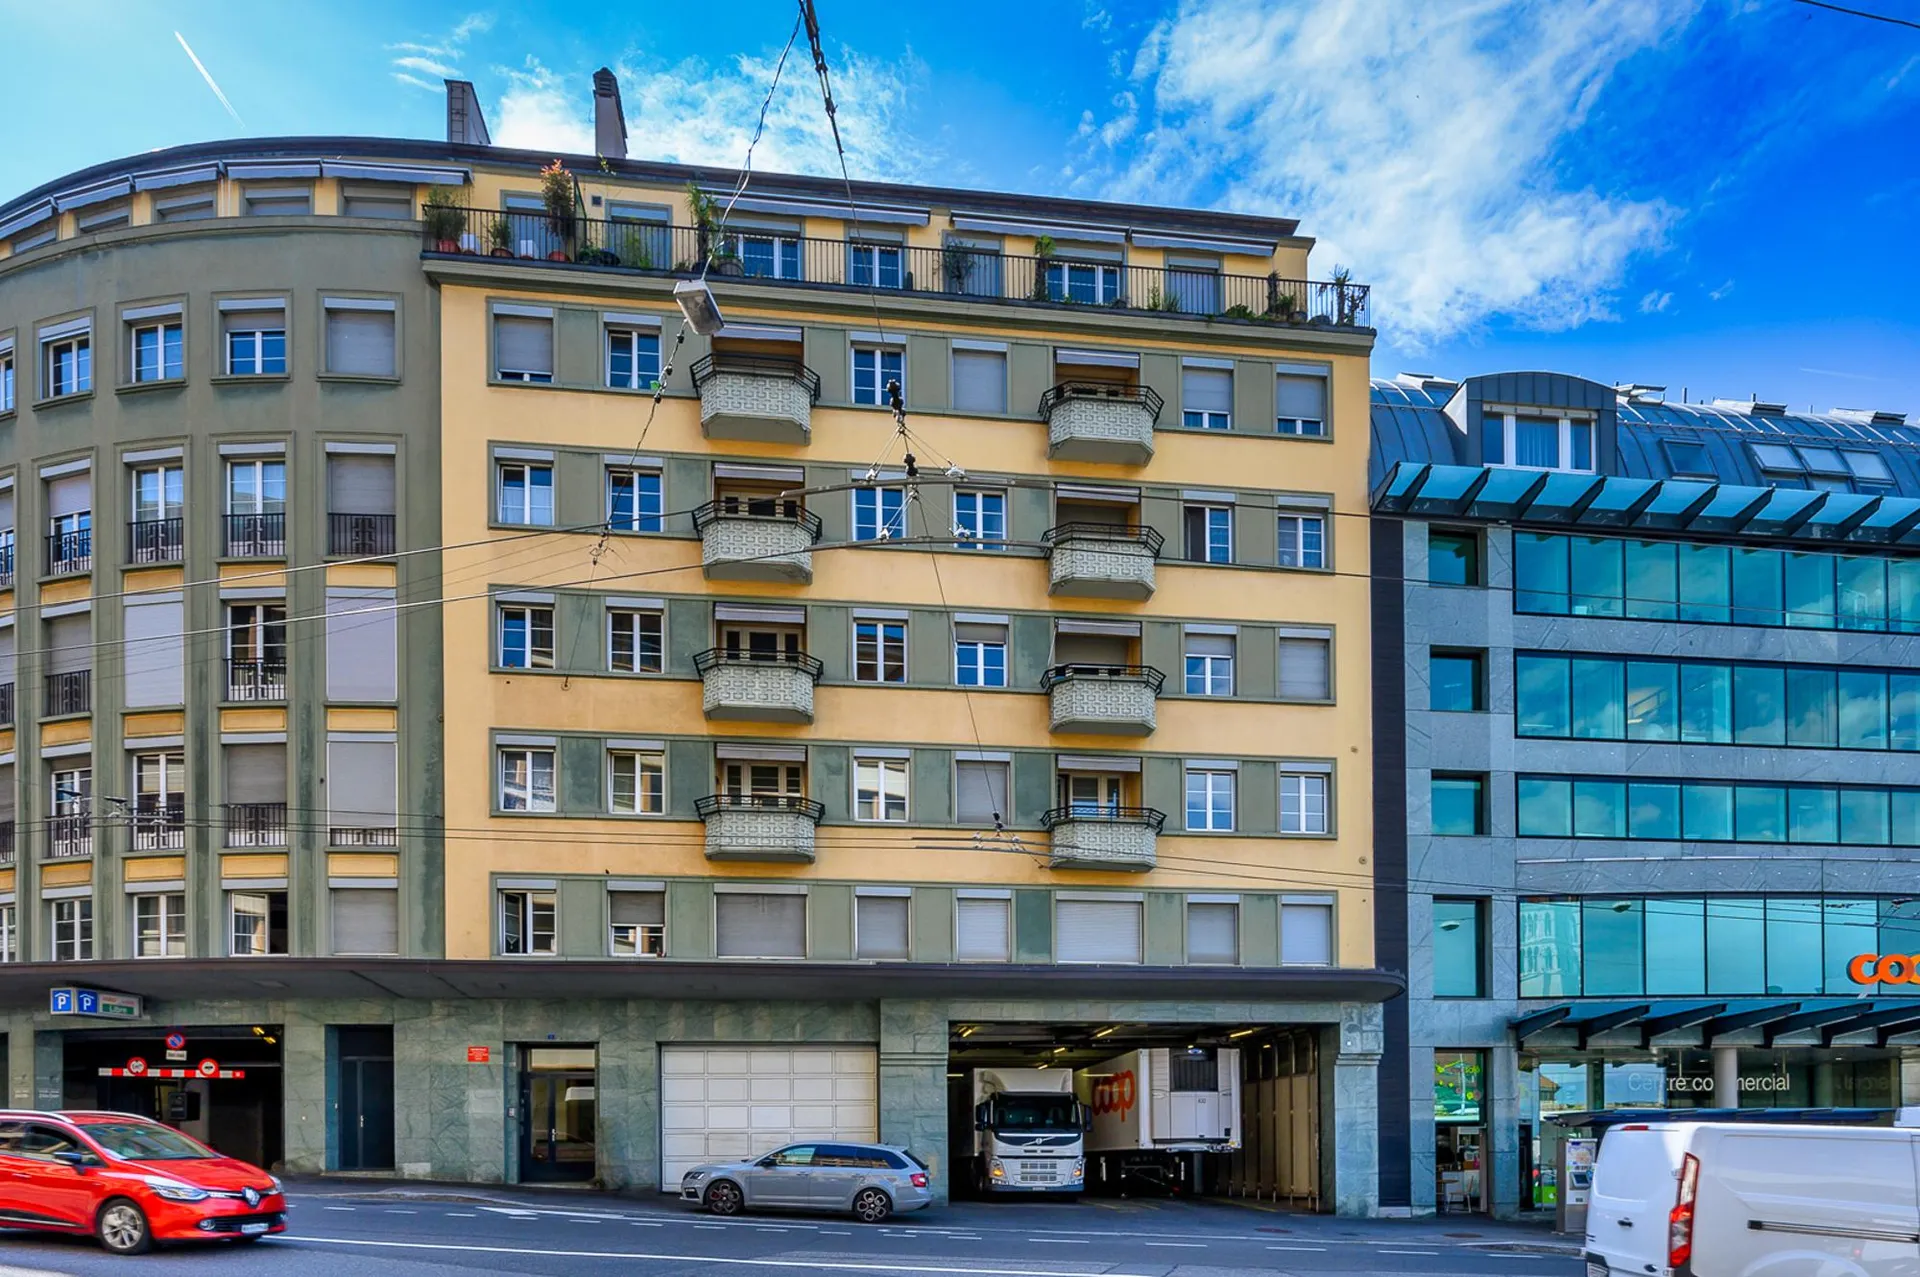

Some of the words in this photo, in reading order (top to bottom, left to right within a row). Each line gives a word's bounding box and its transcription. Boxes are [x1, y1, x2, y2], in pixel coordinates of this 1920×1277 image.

[58, 996, 67, 1010] P
[83, 997, 92, 1011] P
[1628, 1072, 1687, 1091] Cere
[1093, 1070, 1135, 1122] coop
